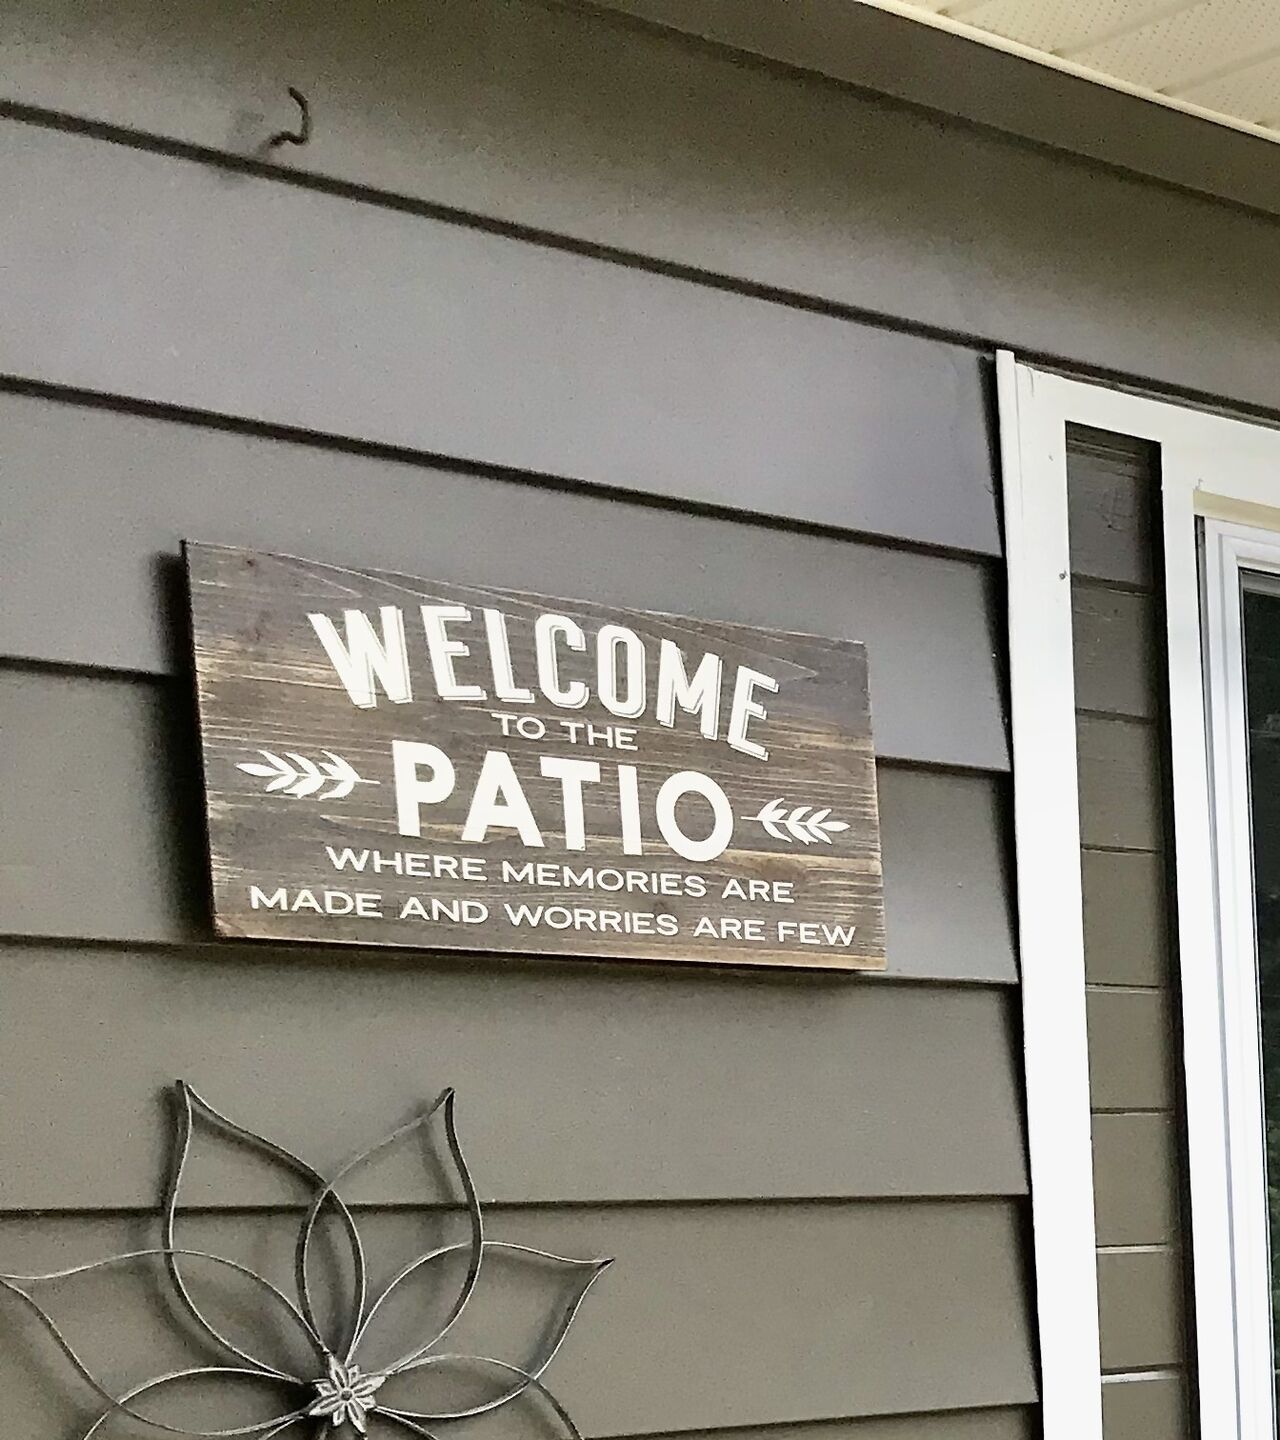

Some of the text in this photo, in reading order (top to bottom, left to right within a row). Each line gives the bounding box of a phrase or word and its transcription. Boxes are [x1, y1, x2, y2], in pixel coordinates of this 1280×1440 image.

[307, 604, 781, 762] WELCOME
[491, 711, 639, 752] TO THE
[391, 739, 735, 863] PATIO
[325, 845, 796, 905] WHERE MEMORIES ARE
[249, 885, 857, 948] MADE AND WORRIES ARE FEW
